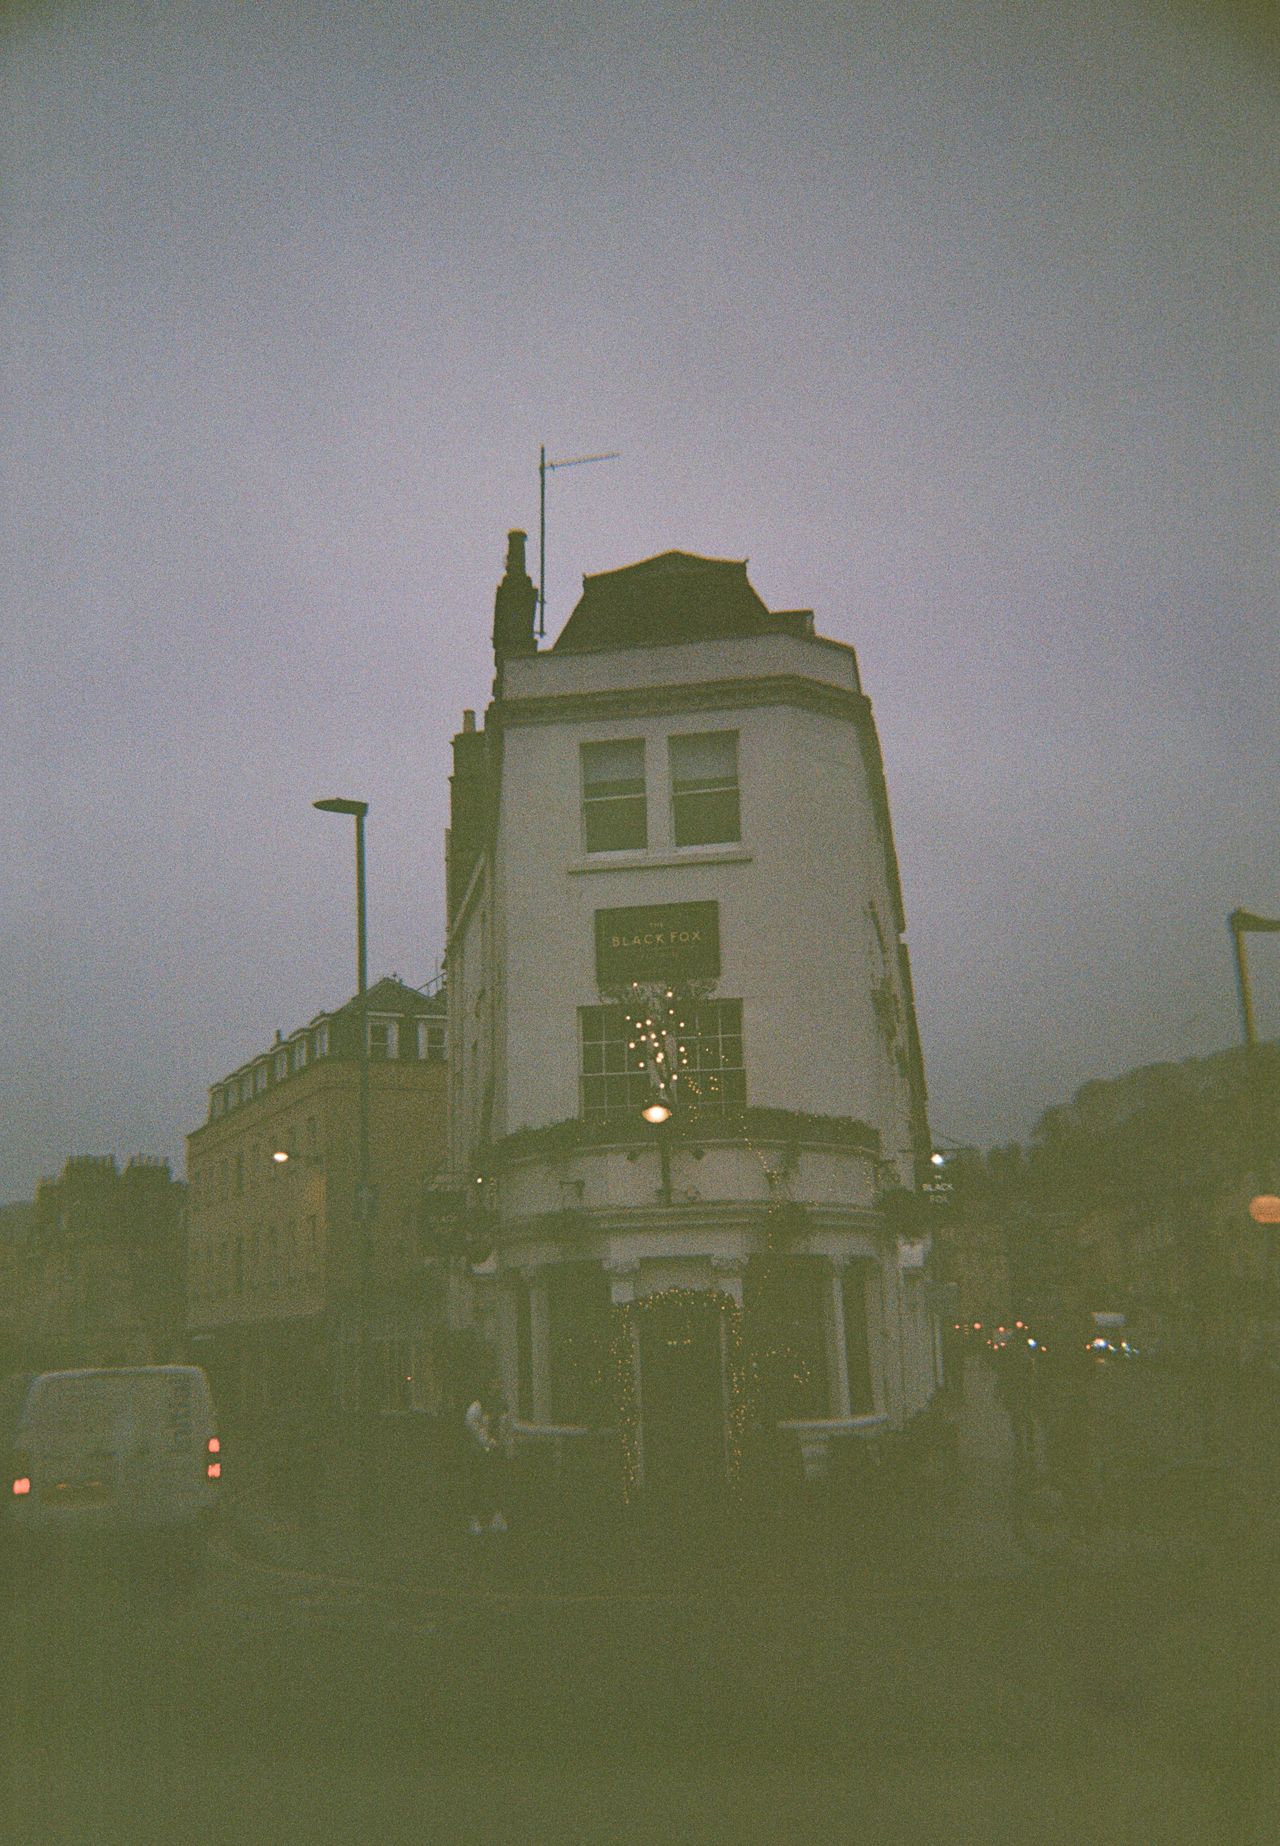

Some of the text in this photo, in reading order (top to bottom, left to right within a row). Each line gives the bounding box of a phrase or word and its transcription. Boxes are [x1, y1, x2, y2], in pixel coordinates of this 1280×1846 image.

[611, 930, 702, 948] BLACK FOX
[922, 1182, 954, 1191] BLACK
